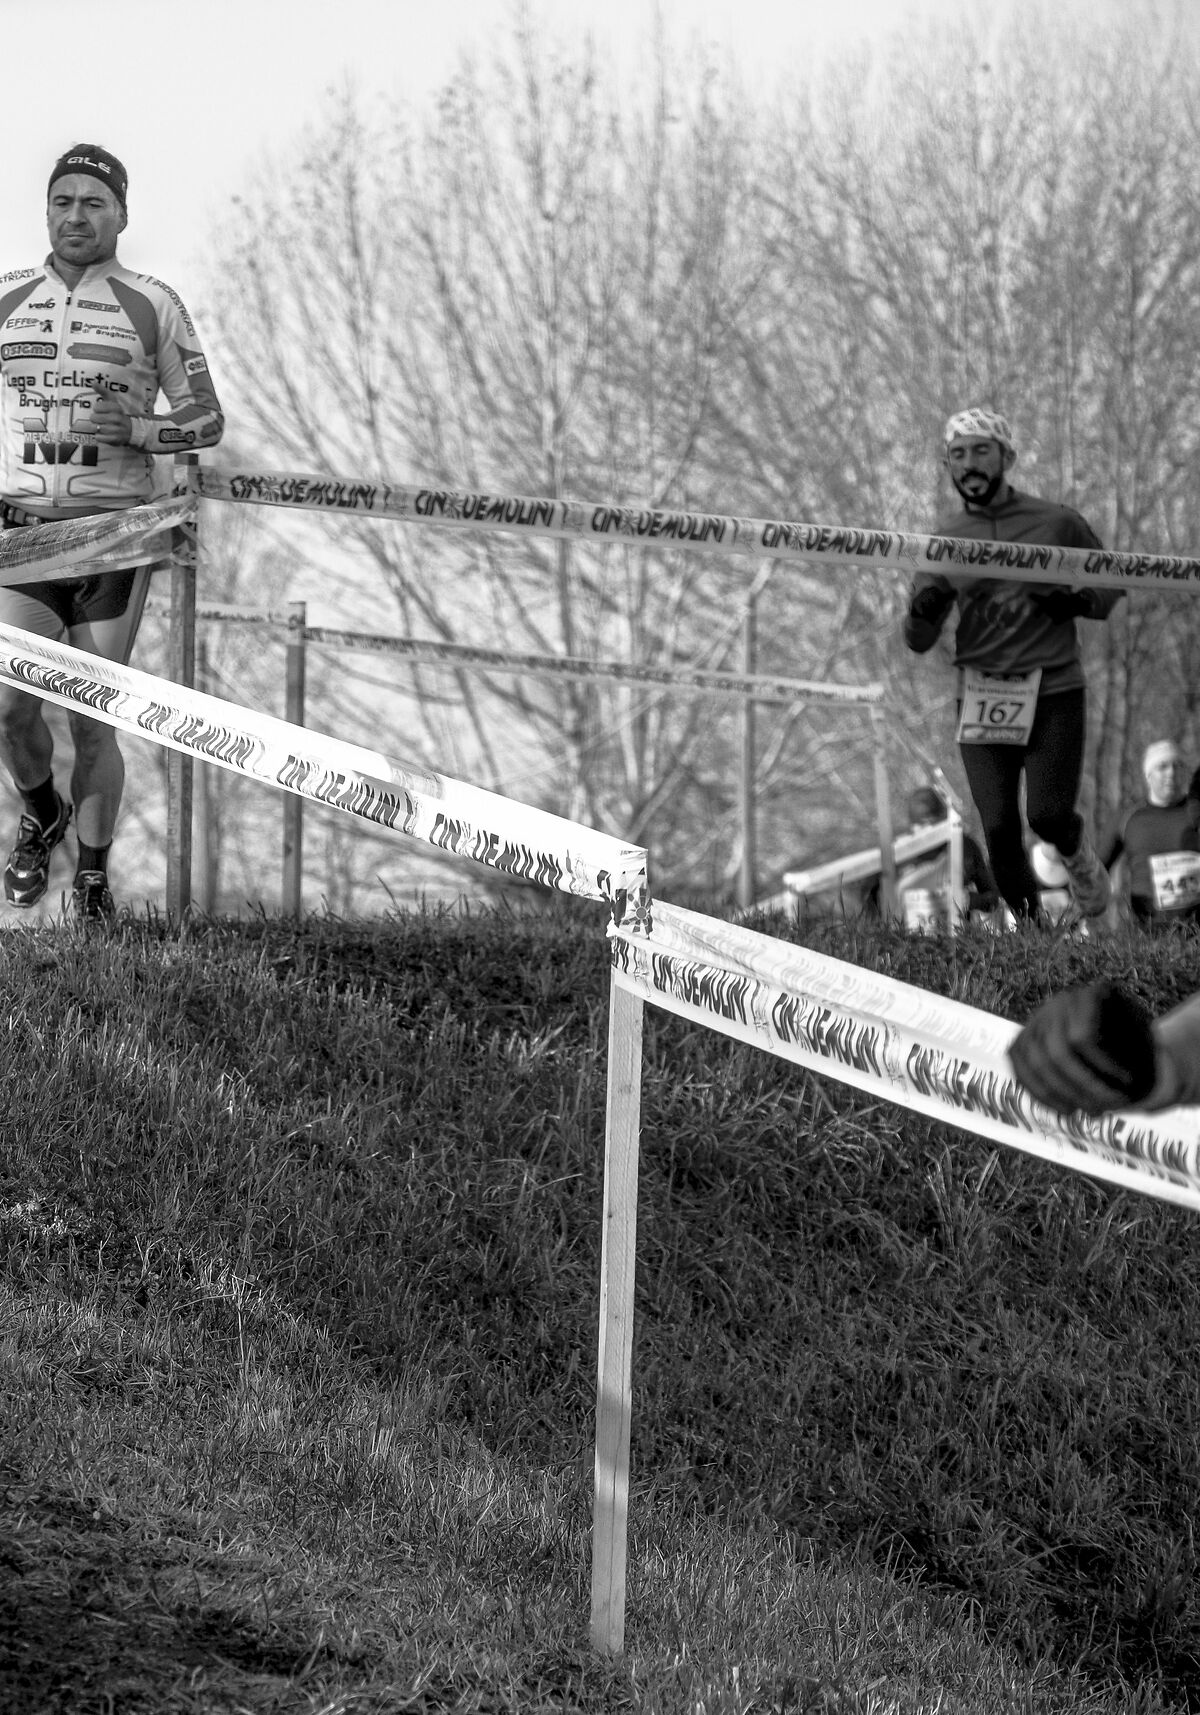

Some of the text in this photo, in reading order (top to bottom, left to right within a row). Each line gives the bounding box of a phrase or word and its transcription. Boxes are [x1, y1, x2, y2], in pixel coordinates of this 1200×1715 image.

[19, 393, 91, 413] Brugherio
[44, 370, 129, 393] Ciclistica
[230, 475, 377, 511] CINUEMULINI
[415, 489, 554, 528] CINUEMULINI
[591, 506, 727, 543] CINUEMULINI
[761, 522, 893, 557] CINUEMULINI
[925, 537, 1053, 570] CINUEMULINI
[977, 701, 1025, 724] 167
[137, 700, 256, 770] CINUEMULINI
[429, 812, 564, 892] CINUEMULINI
[651, 951, 751, 1026] CINUEMULINI
[771, 992, 883, 1078] CINUEMULINI
